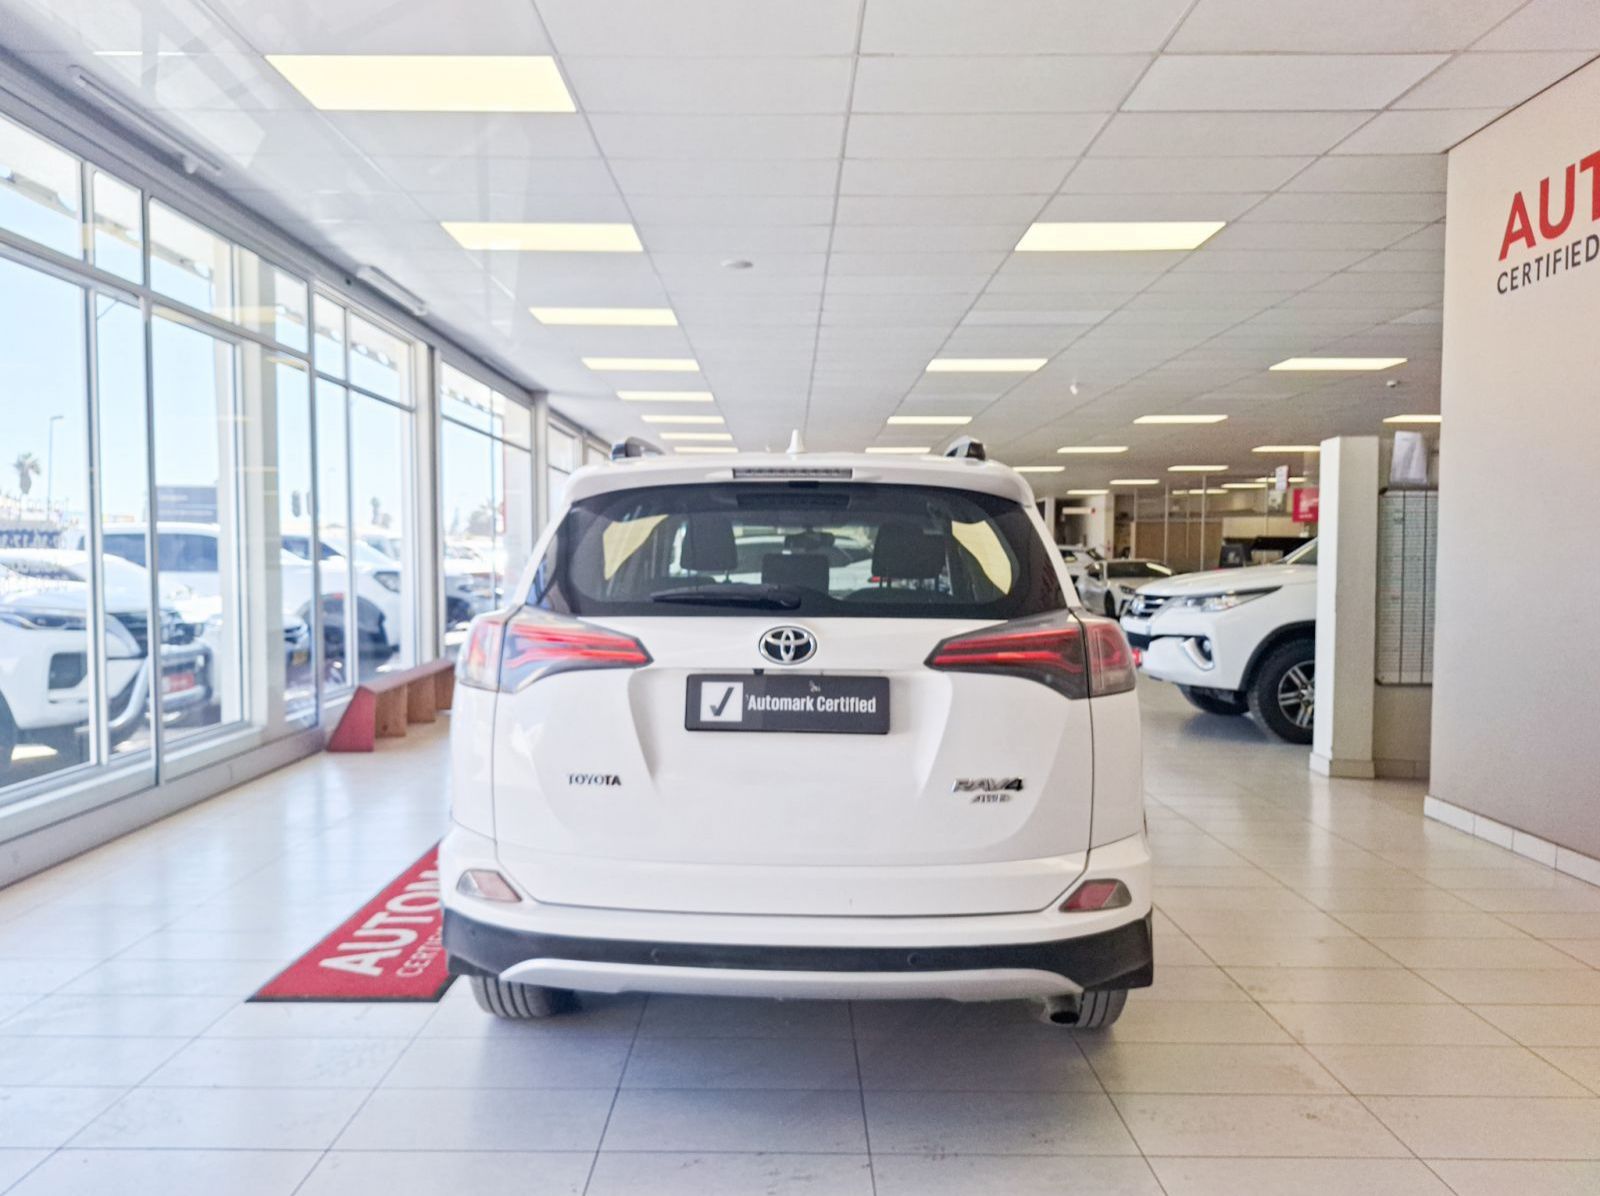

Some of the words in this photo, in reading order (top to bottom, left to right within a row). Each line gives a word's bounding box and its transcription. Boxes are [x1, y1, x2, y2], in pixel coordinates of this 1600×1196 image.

[1498, 149, 1600, 261] AUT
[1497, 234, 1600, 294] CERTIFIED
[747, 695, 814, 711] Automark
[816, 696, 876, 713] Certified
[568, 774, 621, 786] TOYOTA
[952, 778, 1023, 792] RAV4
